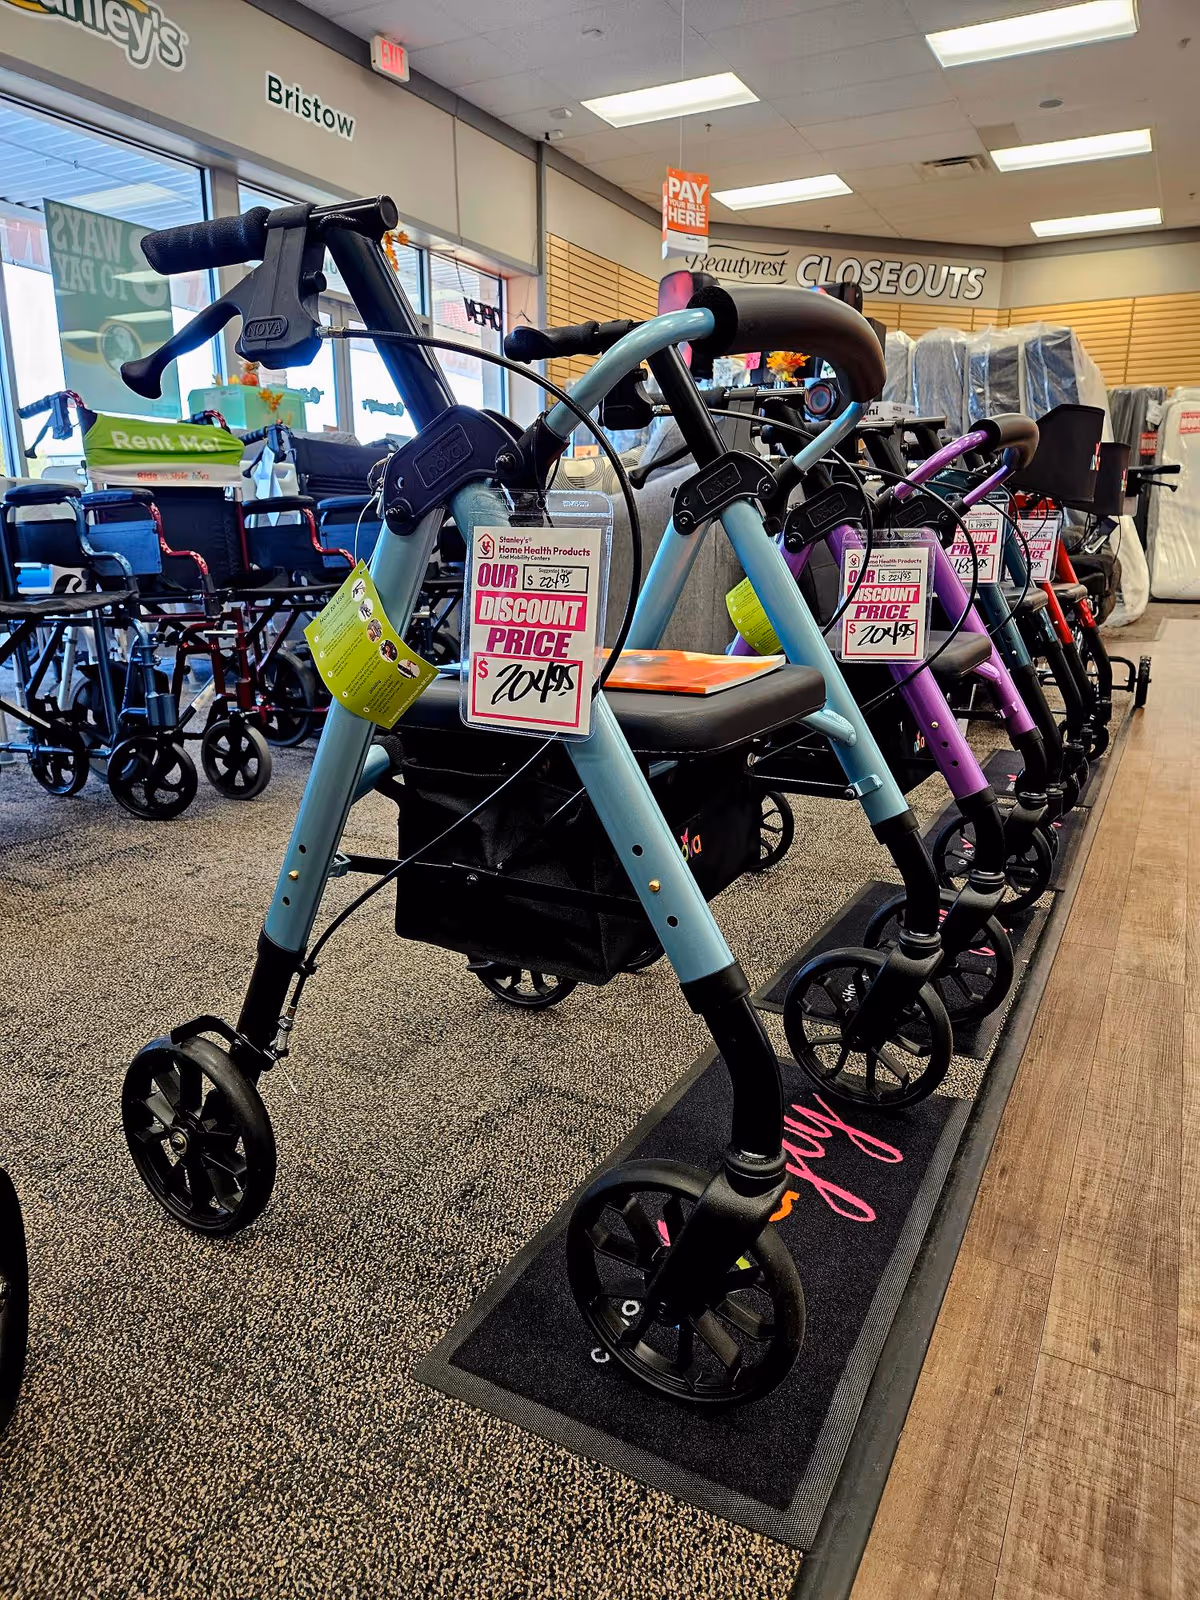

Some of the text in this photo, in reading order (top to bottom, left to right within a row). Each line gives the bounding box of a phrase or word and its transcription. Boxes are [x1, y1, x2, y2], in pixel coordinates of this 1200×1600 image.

[380, 39, 405, 78] EXIT
[268, 74, 354, 137] Bristow
[668, 175, 708, 204] PAY
[669, 197, 705, 212] YOUR BILLS
[668, 205, 706, 228] HERE
[685, 252, 987, 300] Beautyrest CLOSEOUTS
[247, 321, 282, 337] NOVA
[110, 430, 222, 452] Rent Me!
[498, 545, 591, 557] Home Health Products
[477, 562, 519, 589] OUR
[527, 575, 533, 586] $
[848, 569, 876, 584] OR
[478, 595, 583, 626] DISCOUNT
[854, 604, 911, 619] PRICE
[848, 623, 856, 635] $
[485, 627, 572, 659] PRICE
[477, 658, 489, 680] $
[681, 834, 702, 862] ova
